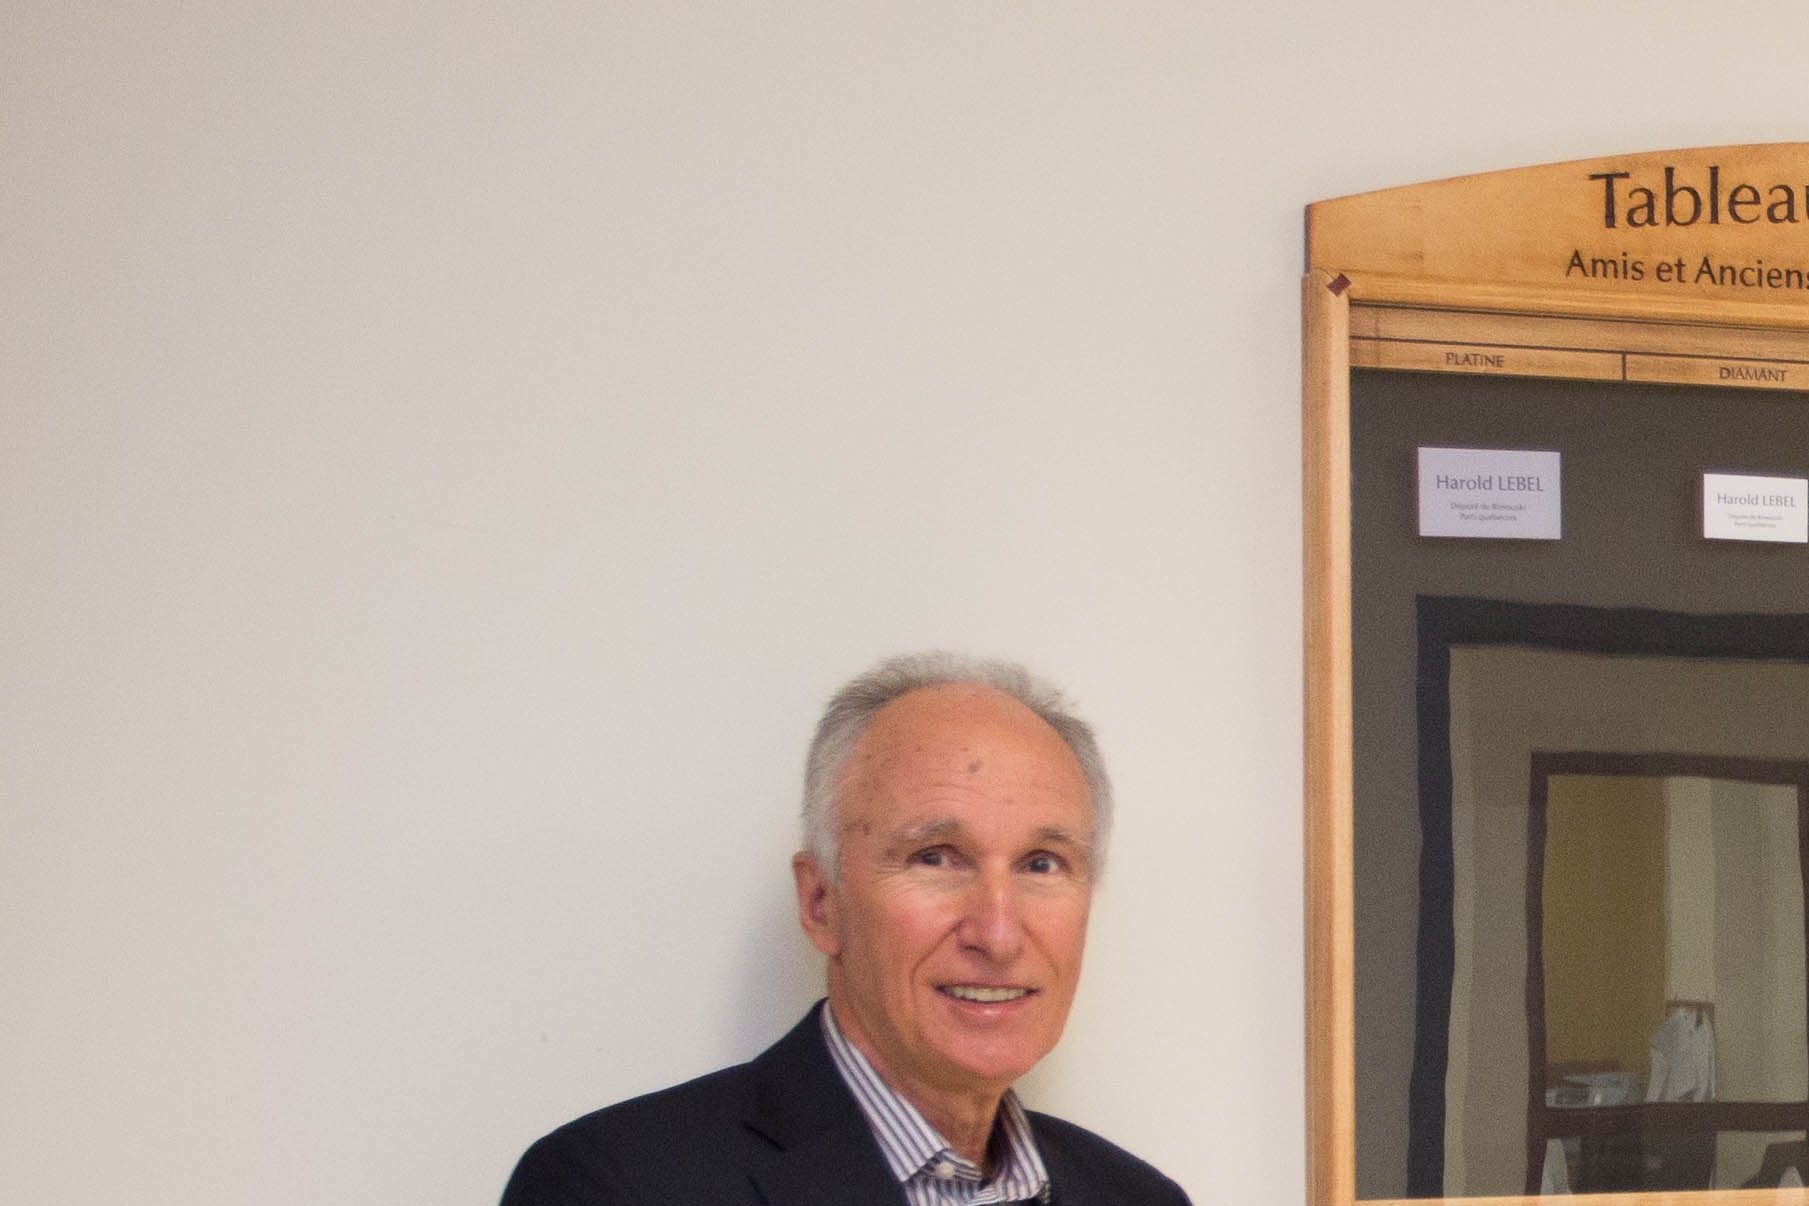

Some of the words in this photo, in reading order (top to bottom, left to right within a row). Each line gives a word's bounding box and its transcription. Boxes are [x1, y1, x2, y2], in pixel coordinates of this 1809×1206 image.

[1565, 249, 1644, 282] Amis
[1656, 257, 1686, 284] et
[1445, 352, 1505, 369] PLATINE
[1719, 366, 1787, 383] DIAMANT
[1436, 475, 1493, 491] Harold
[1498, 475, 1544, 492] LEBEL
[1717, 493, 1759, 505] Harold
[1762, 495, 1797, 507] LEBEL
